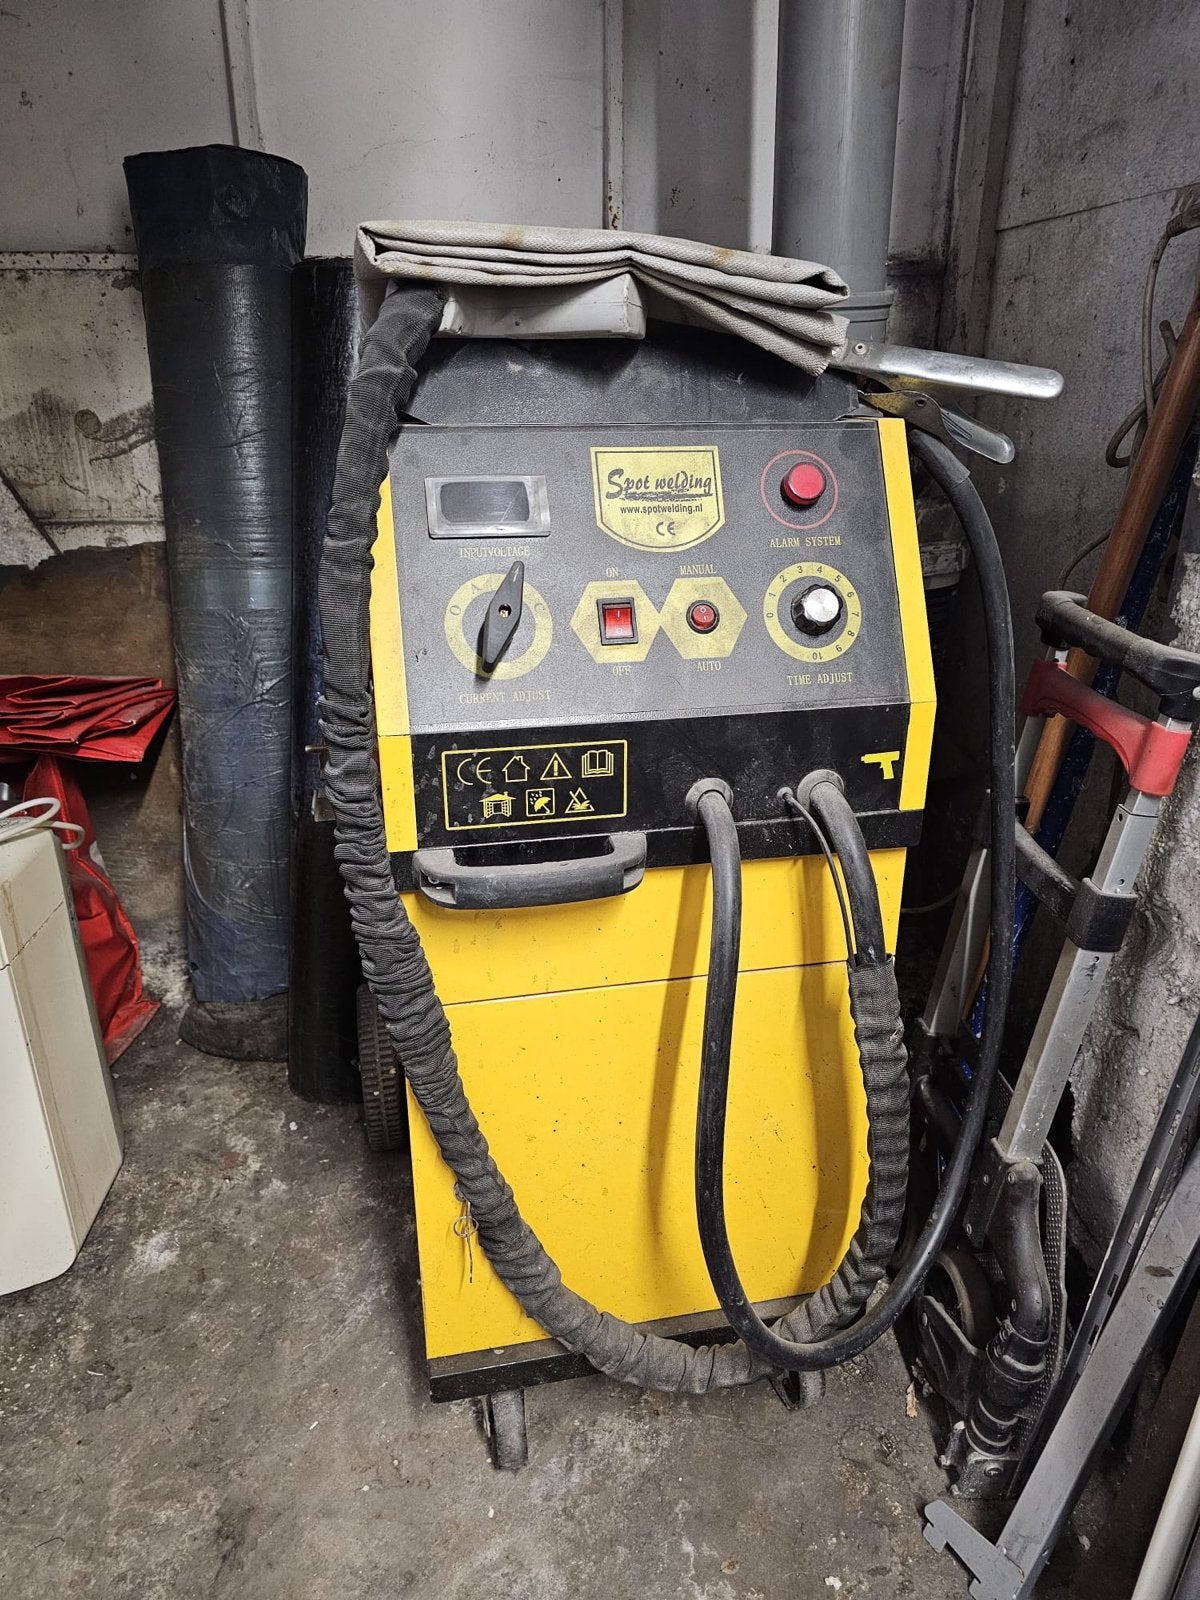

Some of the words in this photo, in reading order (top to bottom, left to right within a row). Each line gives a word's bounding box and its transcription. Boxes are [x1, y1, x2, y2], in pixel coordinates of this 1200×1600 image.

[606, 468, 649, 499] Spot
[655, 470, 712, 495] welding
[620, 503, 703, 515] www.spotwelding.nl
[769, 538, 800, 548] ALARM
[805, 536, 842, 547] SYSTEM
[459, 545, 531, 558] INPUTVOLTAGE
[606, 566, 619, 577] ON
[679, 564, 717, 575] MANUAL
[812, 652, 823, 660] 10
[697, 661, 721, 671] AUTO
[787, 675, 811, 685] TIME
[817, 672, 853, 684] ADJUST
[459, 692, 505, 704] CURRENT
[513, 690, 551, 702] ADJUST
